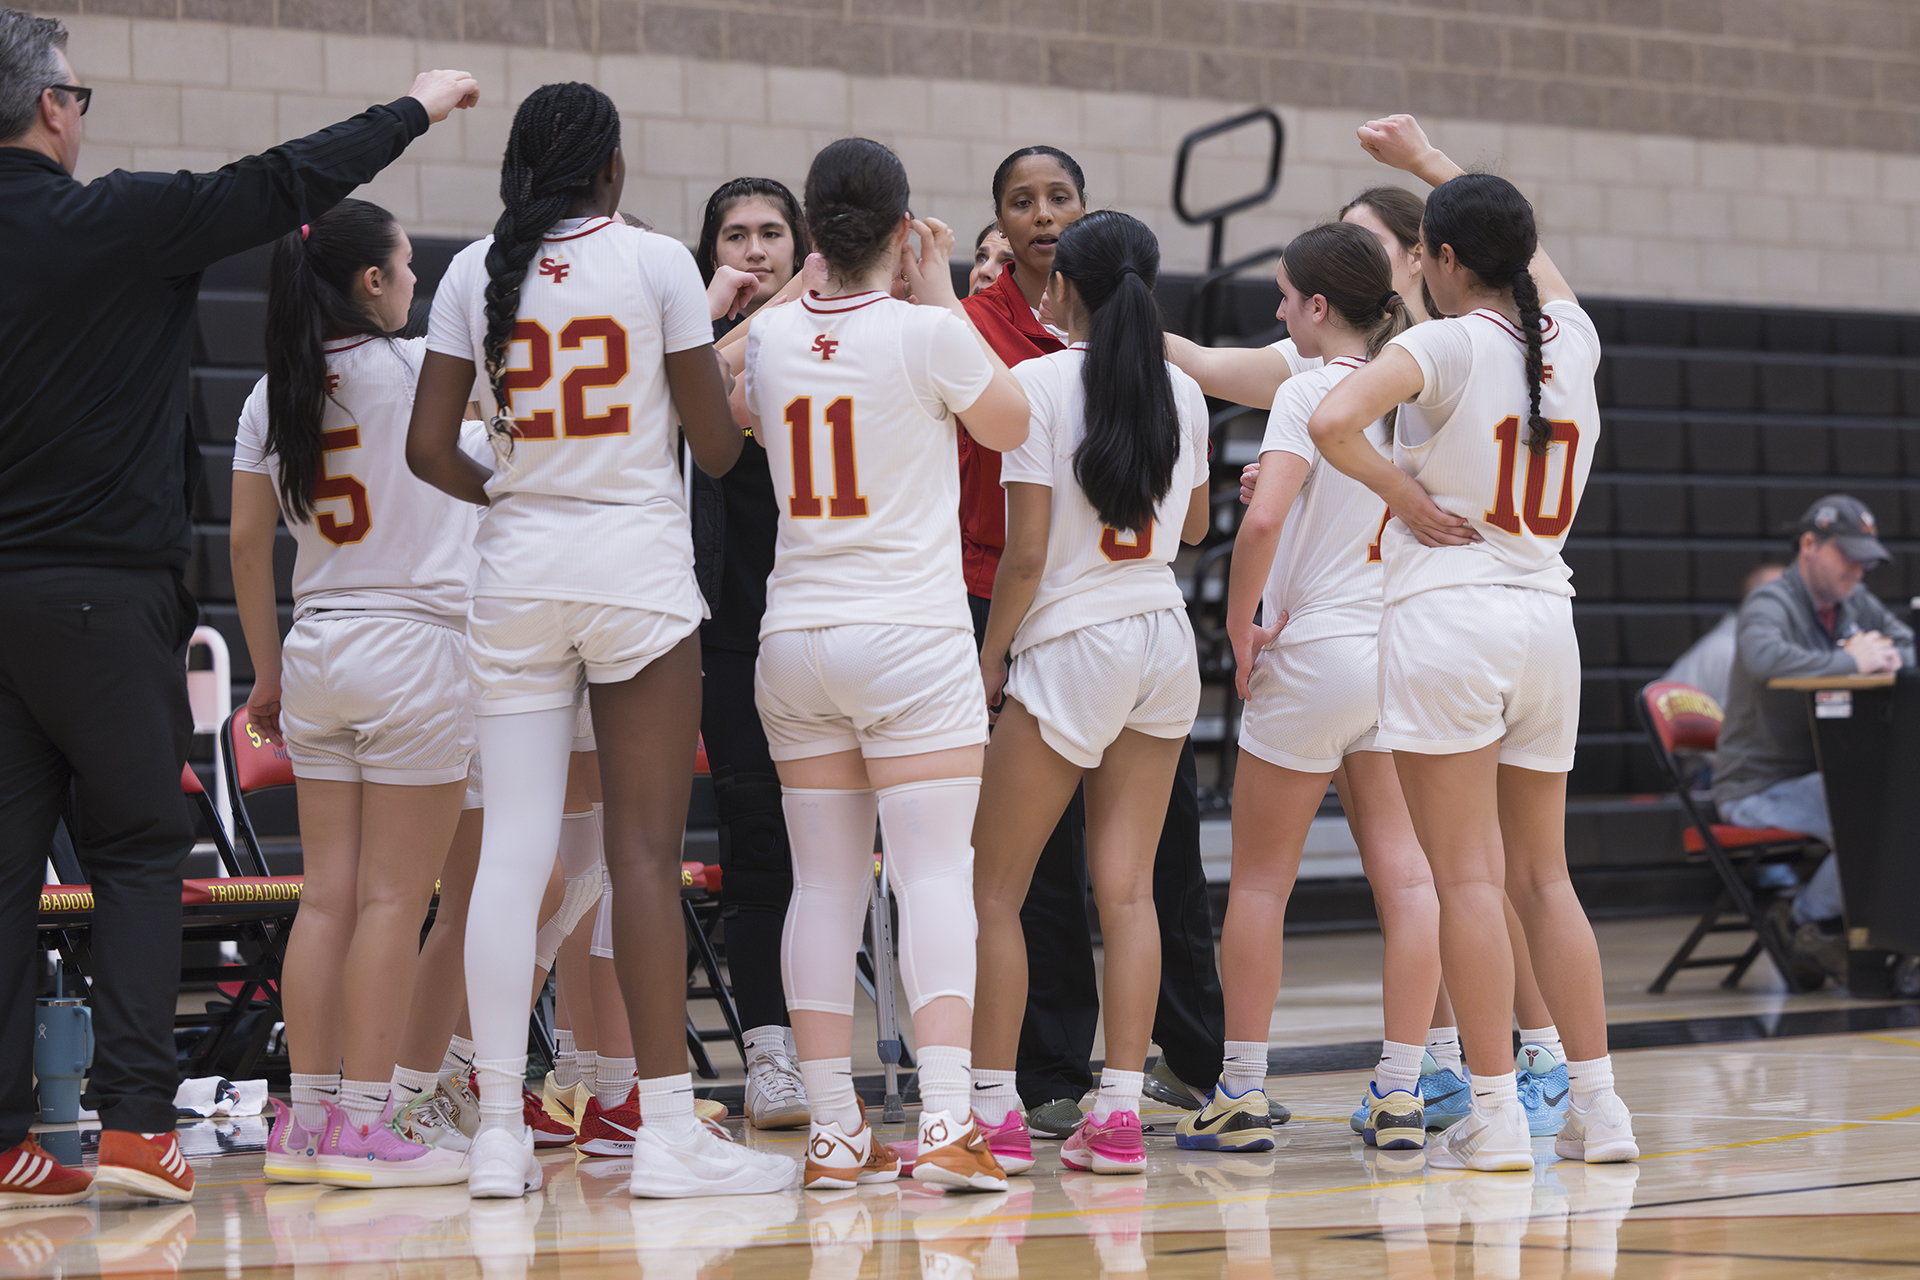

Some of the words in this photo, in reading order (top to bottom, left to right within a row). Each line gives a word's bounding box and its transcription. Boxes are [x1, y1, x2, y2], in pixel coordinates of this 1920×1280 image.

[537, 256, 572, 286] SF
[810, 332, 840, 362] SF
[326, 373, 340, 395] F
[497, 315, 631, 441] 22
[1540, 364, 1555, 386] F
[783, 395, 870, 520] 11
[313, 425, 373, 547] 5
[1483, 414, 1580, 539] 10
[38, 893, 95, 911] BADOU
